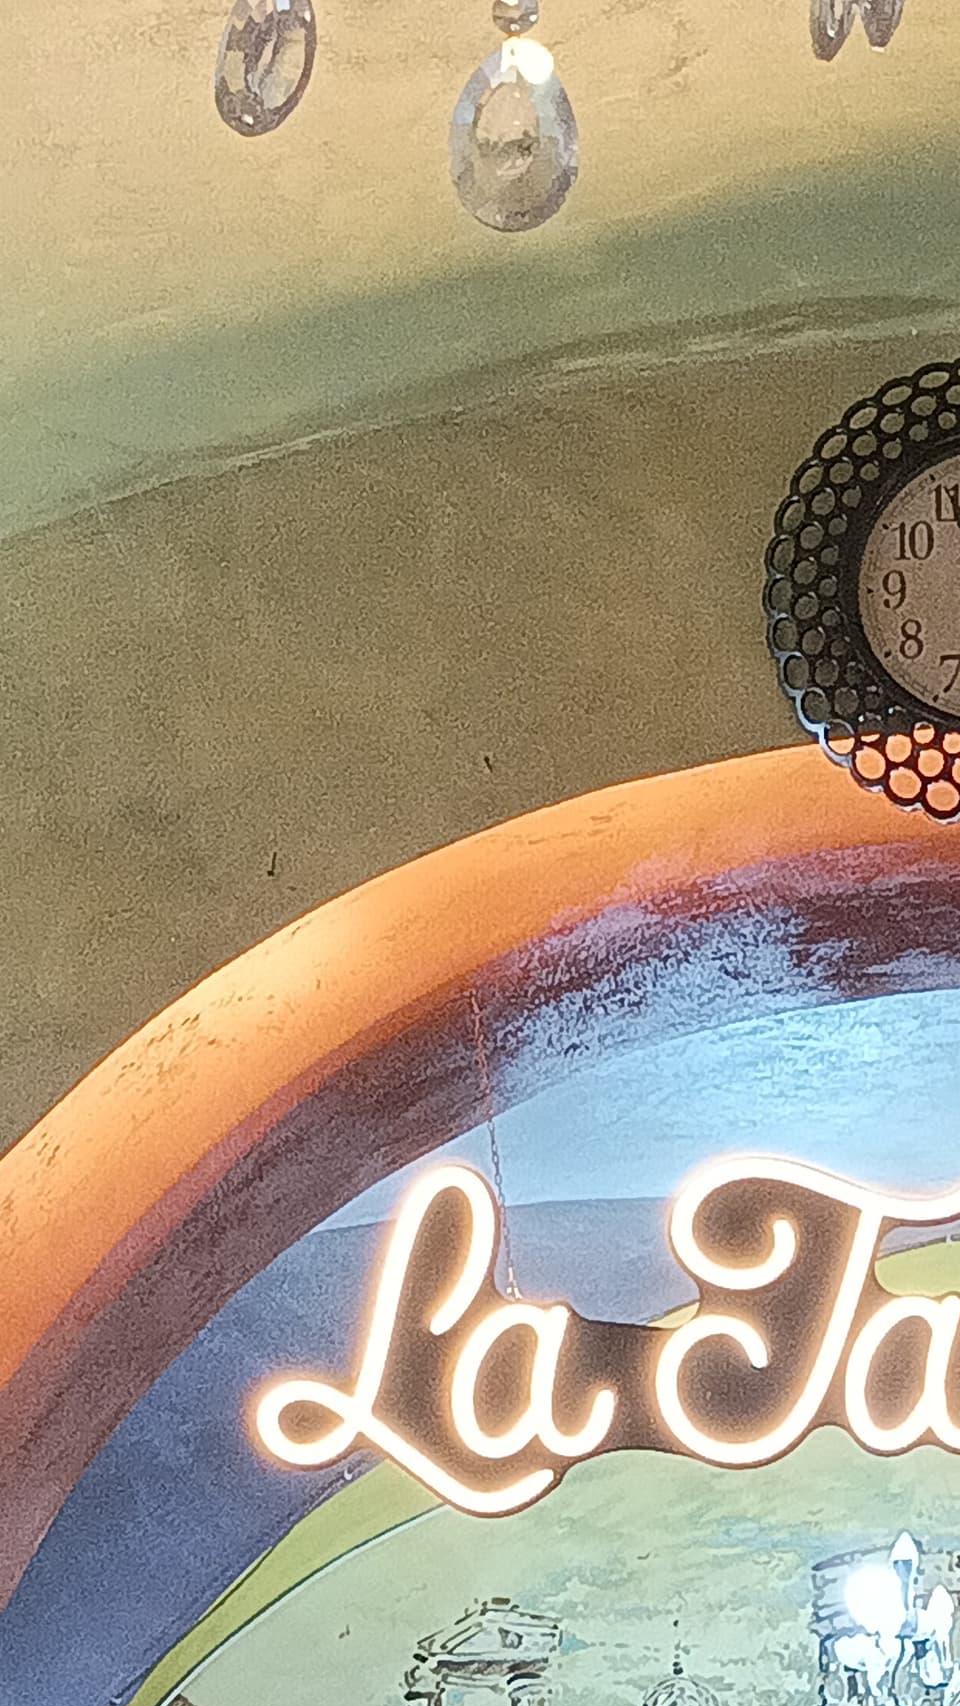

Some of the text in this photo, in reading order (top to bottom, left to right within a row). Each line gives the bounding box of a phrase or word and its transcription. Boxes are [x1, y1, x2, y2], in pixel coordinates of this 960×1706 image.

[934, 484, 960, 522] 11
[897, 521, 934, 560] 10
[882, 570, 906, 609] 9
[900, 619, 924, 659] 8
[256, 1164, 618, 1516] La
